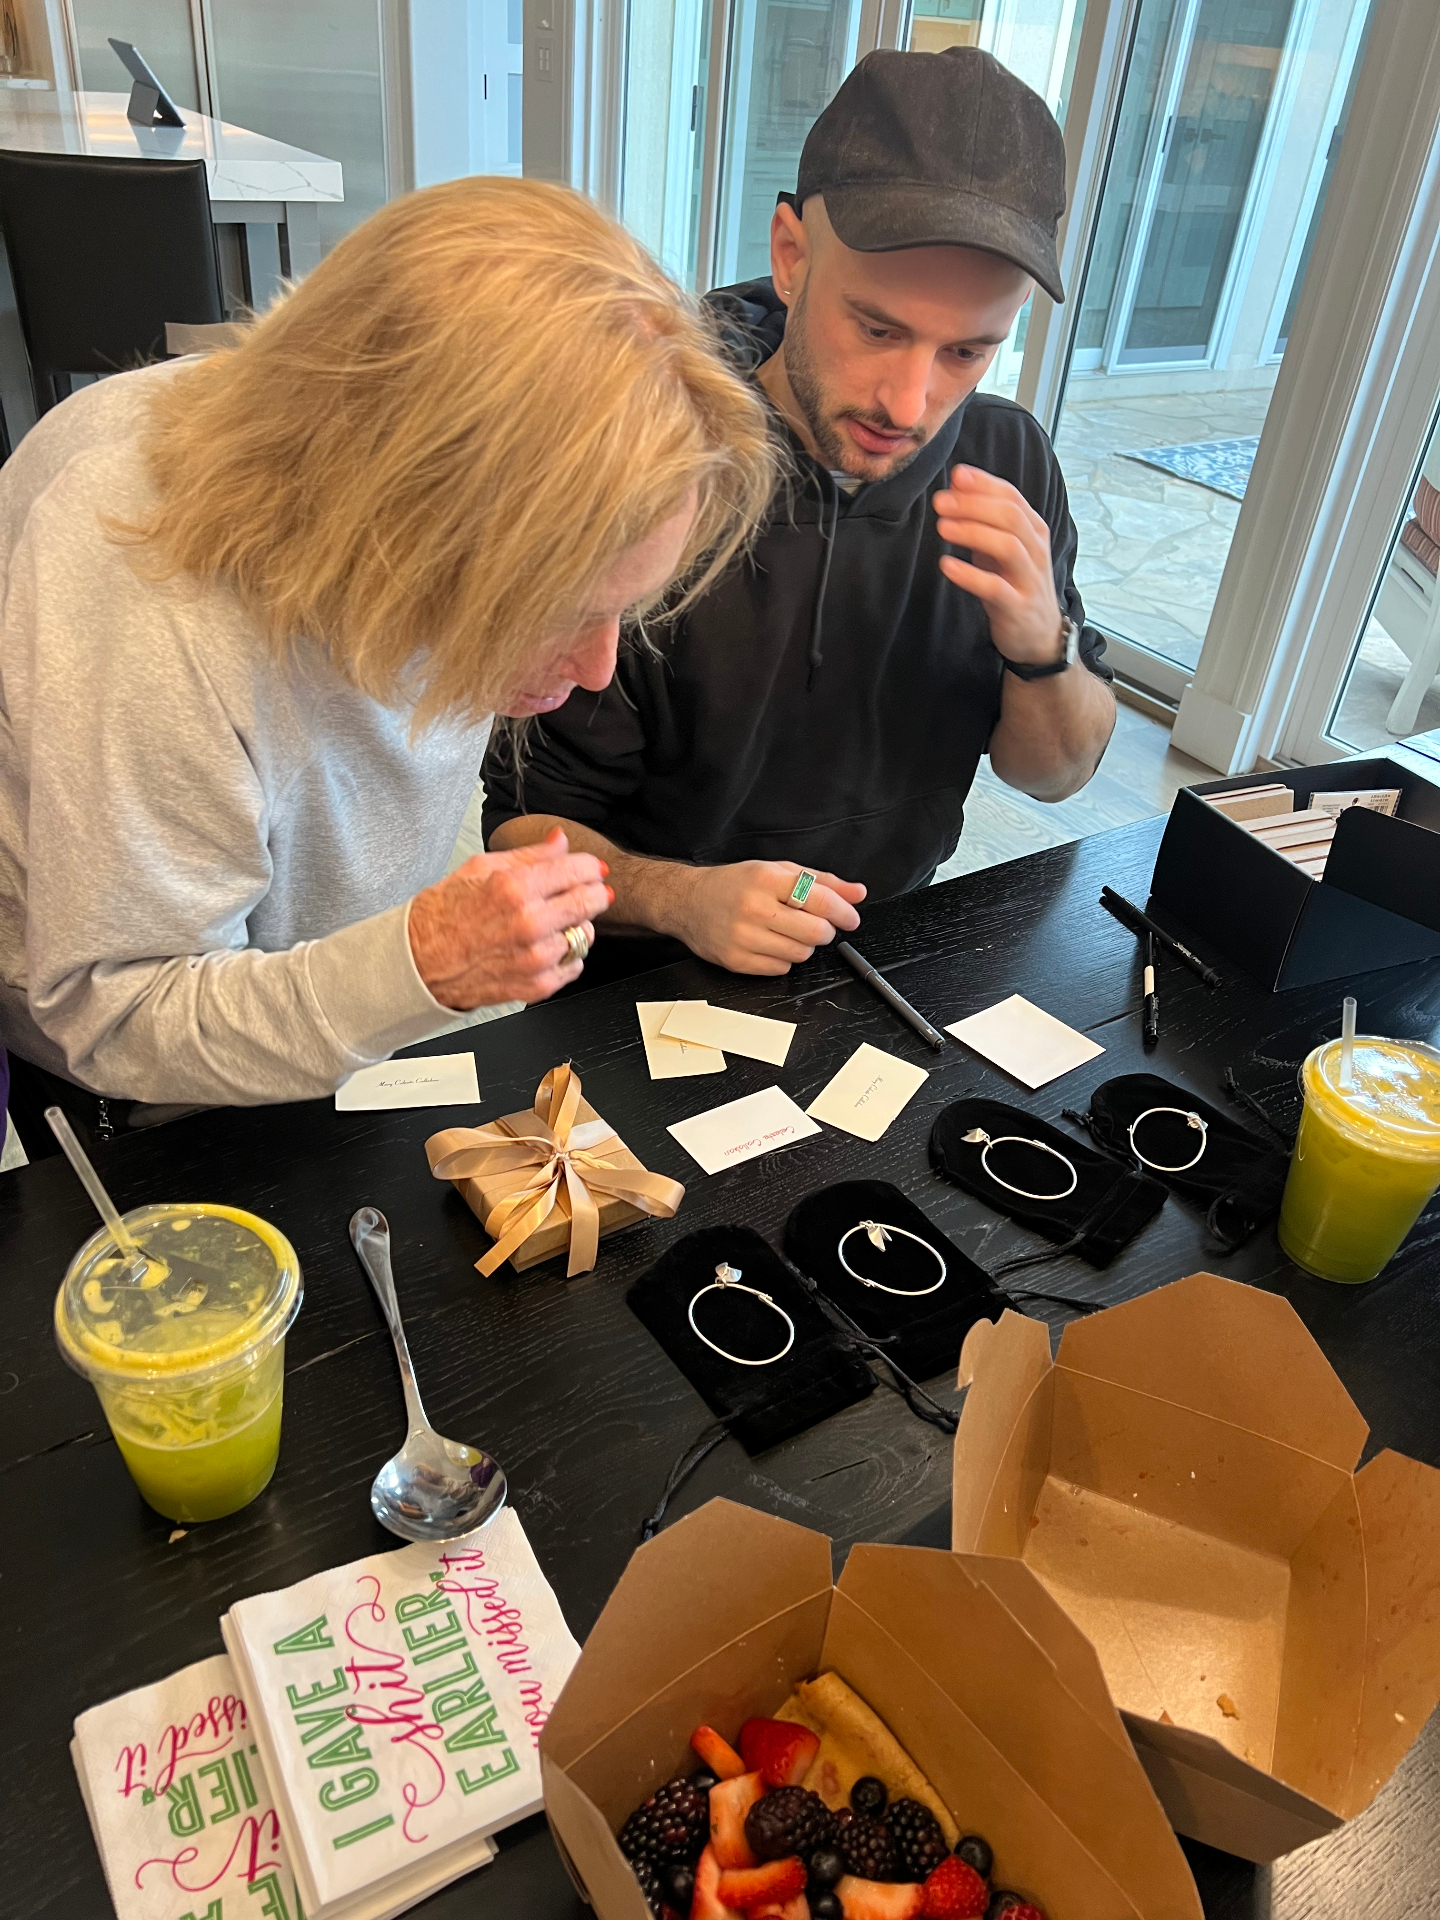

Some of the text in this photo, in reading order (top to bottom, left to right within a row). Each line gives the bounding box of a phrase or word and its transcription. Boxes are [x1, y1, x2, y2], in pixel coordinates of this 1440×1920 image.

[438, 1548, 486, 1576] it
[435, 1576, 533, 1675] missed
[114, 1694, 248, 1798] issed it
[272, 1613, 396, 1851] I GAVE A
